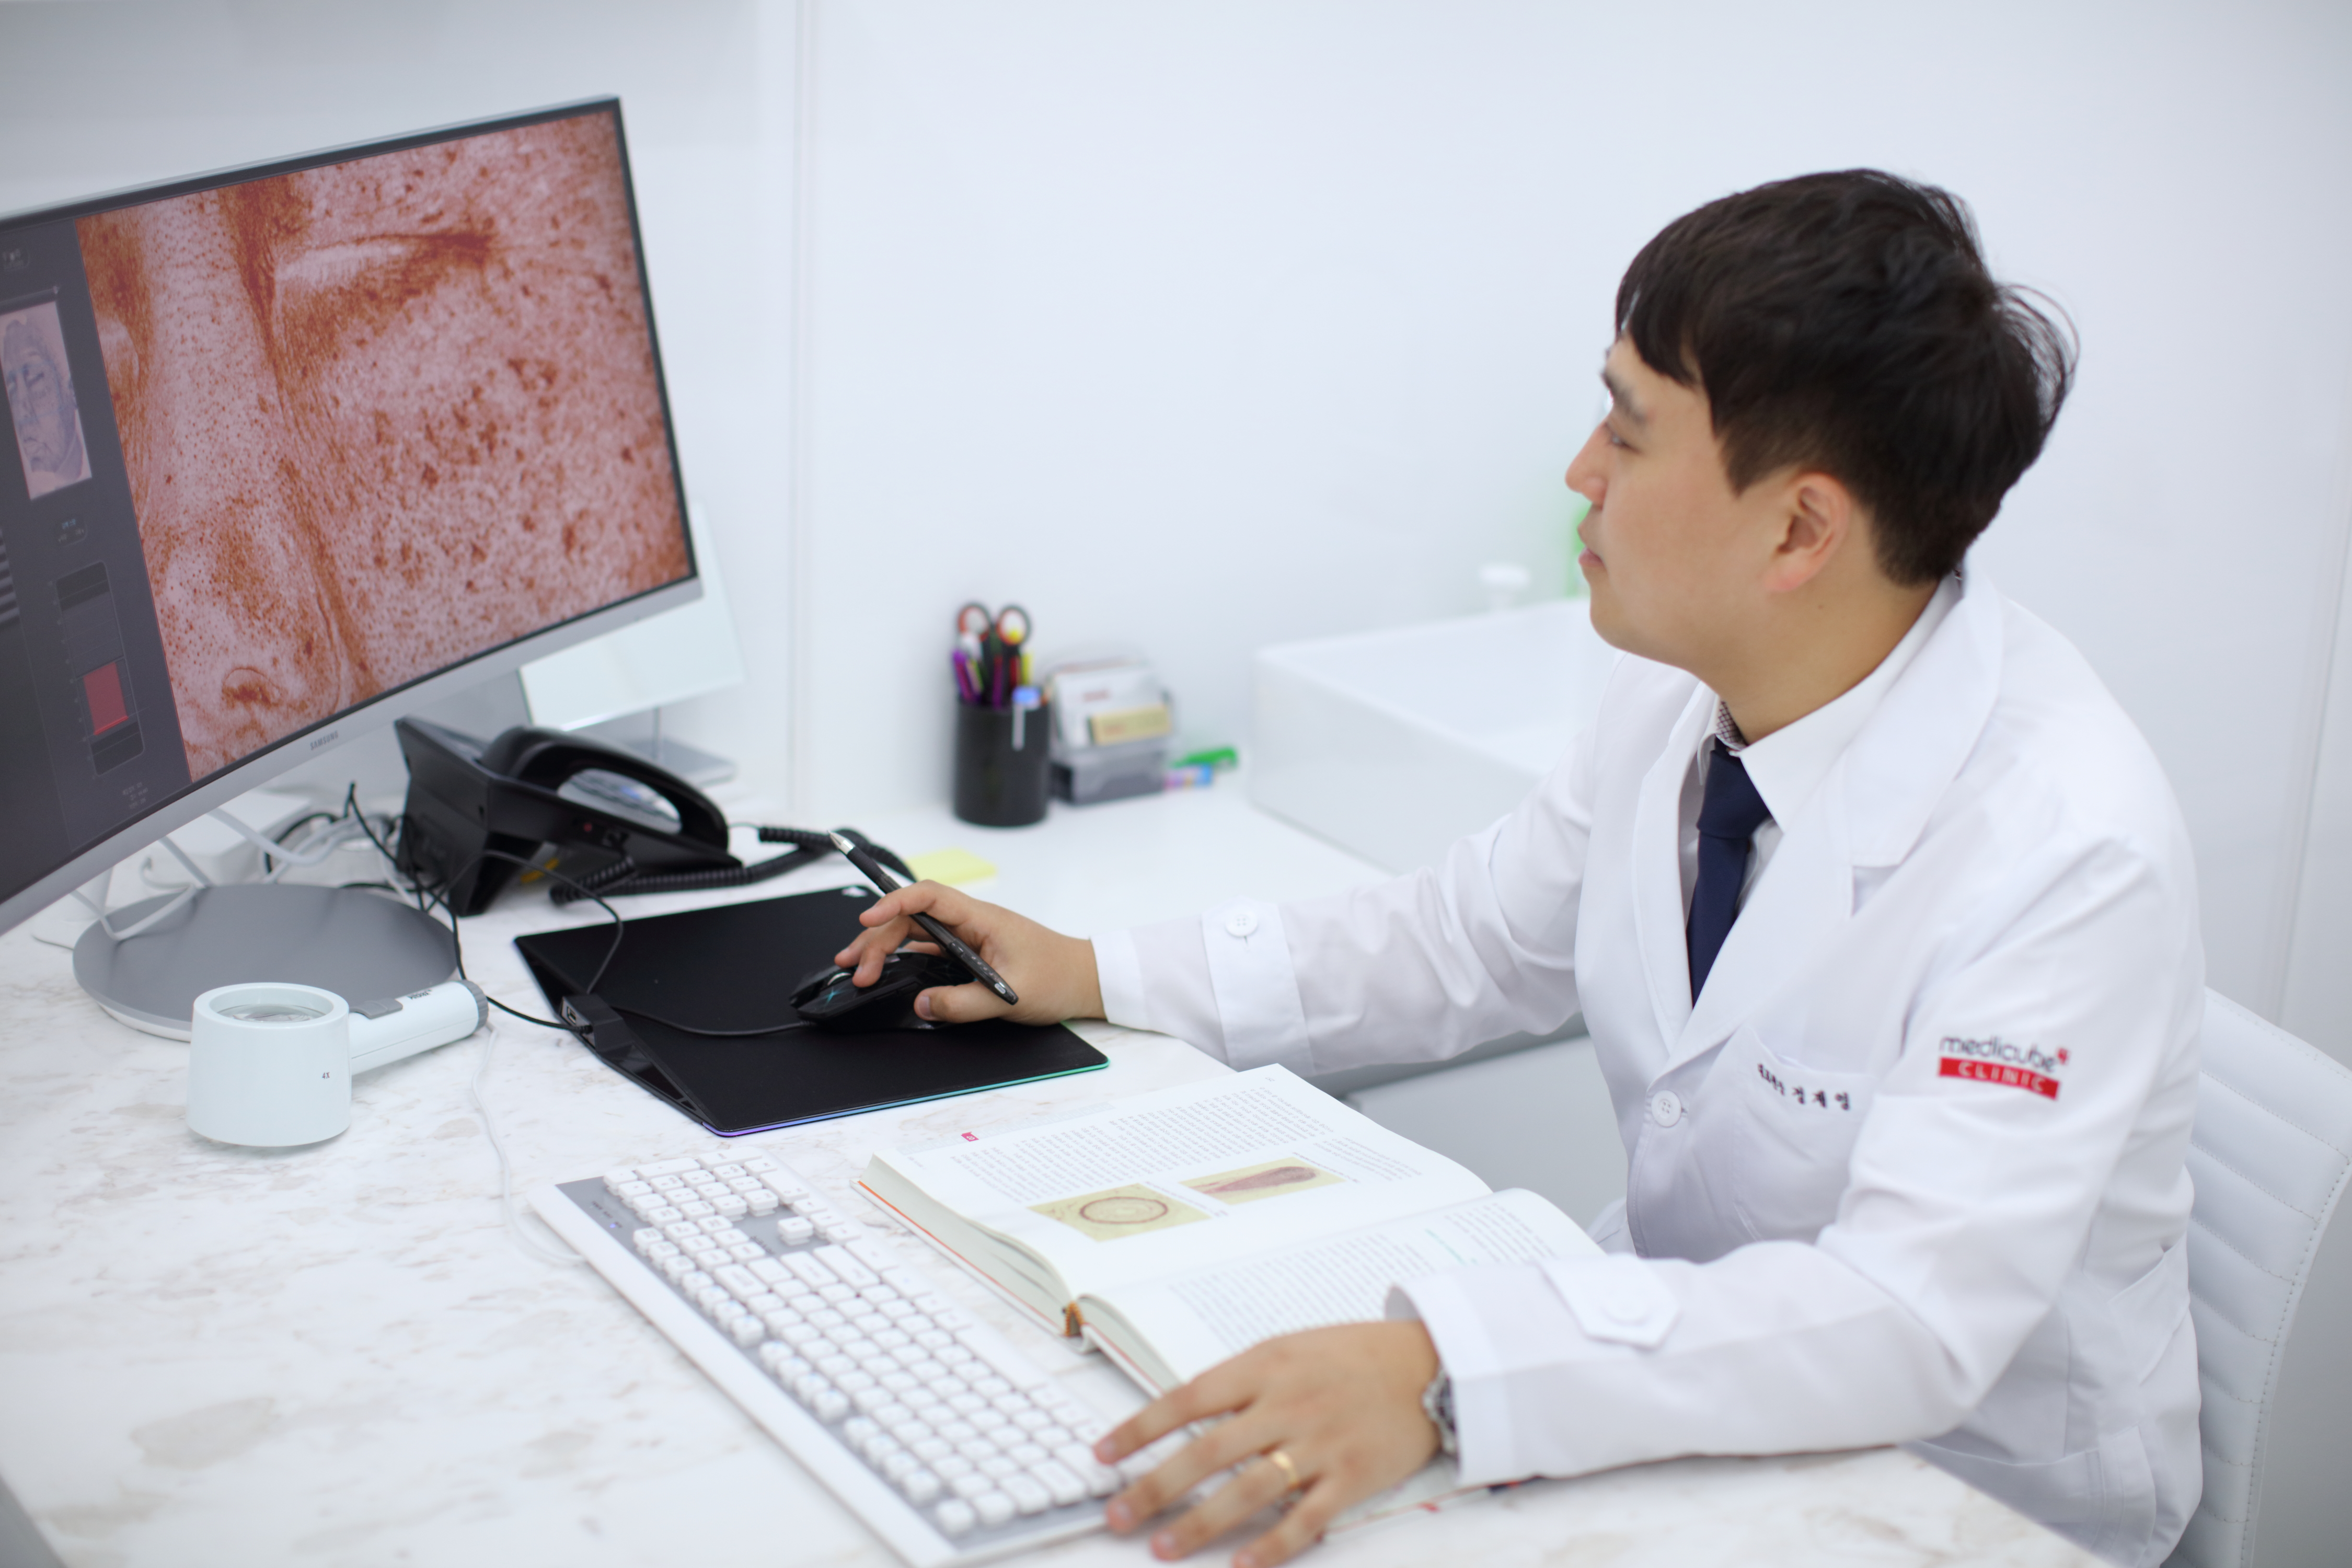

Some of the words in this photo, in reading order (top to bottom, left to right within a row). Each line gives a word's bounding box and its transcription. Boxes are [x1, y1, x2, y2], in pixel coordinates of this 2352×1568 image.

[309, 730, 339, 751] SAMSUNG
[1939, 1035, 2056, 1073] medicube
[1958, 1061, 2046, 1093] CLINIC
